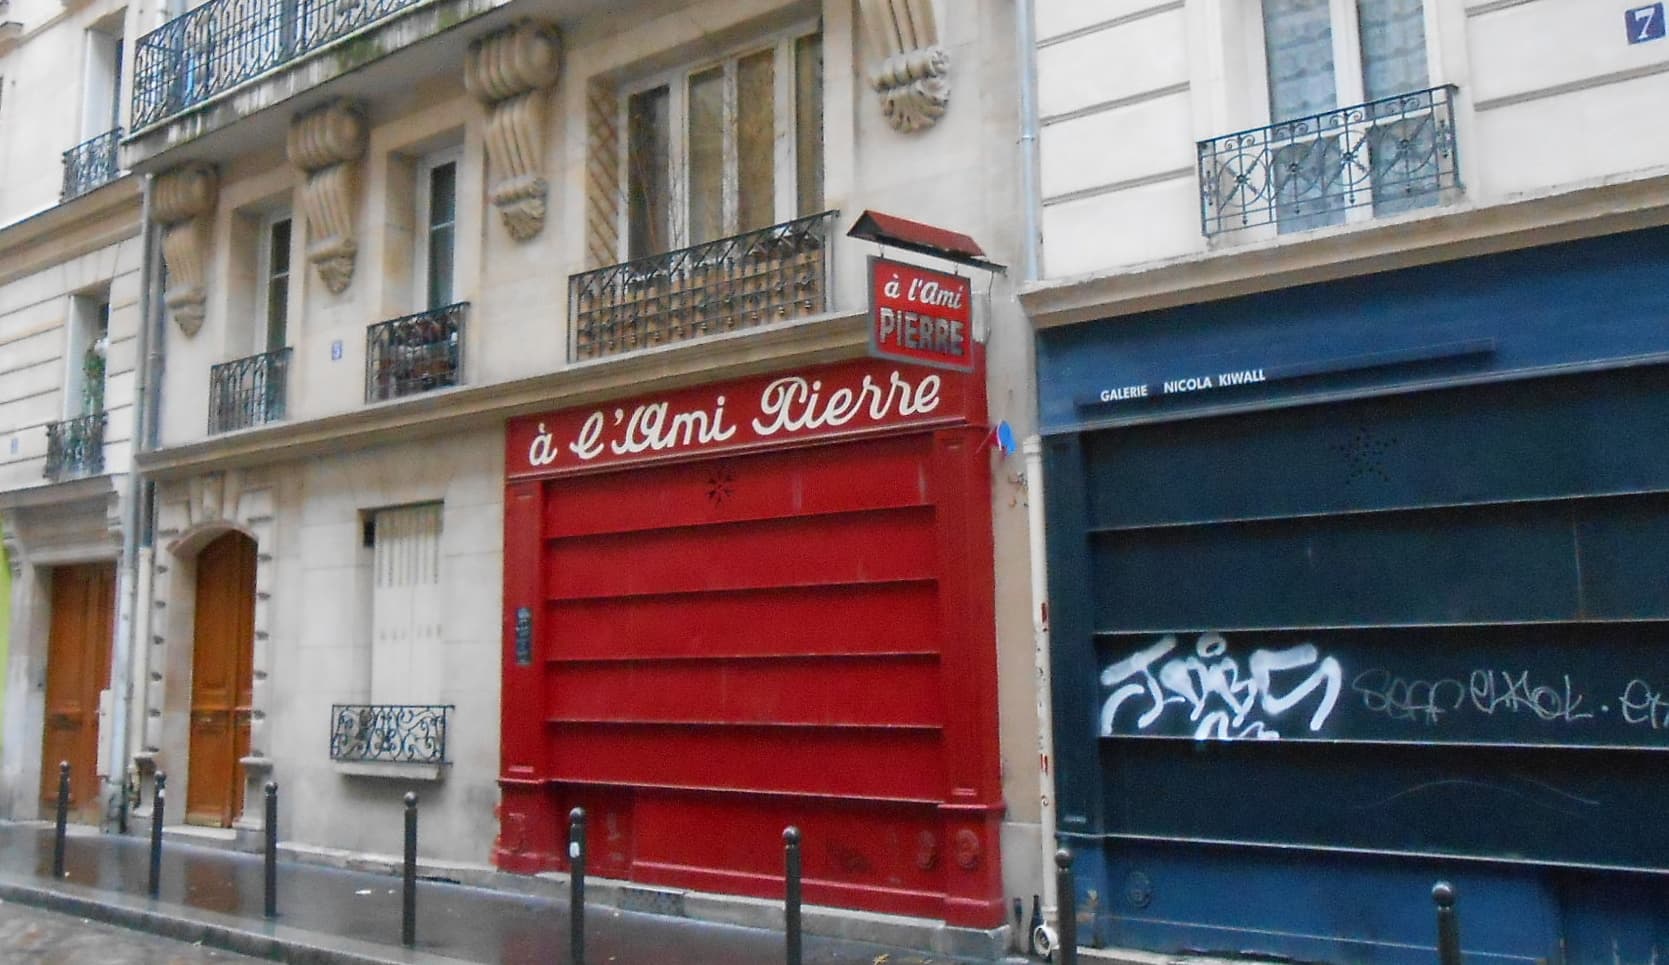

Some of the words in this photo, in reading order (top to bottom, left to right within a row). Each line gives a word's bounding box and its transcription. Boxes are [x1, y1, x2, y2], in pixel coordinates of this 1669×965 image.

[1635, 8, 1655, 39] 7
[884, 273, 900, 298] à
[908, 278, 962, 309] l'Ami
[880, 307, 965, 356] PIERRE
[1100, 384, 1148, 402] GALERIE
[1163, 376, 1213, 394] NICOLA
[1218, 368, 1266, 387] KIWALL
[529, 422, 558, 466] à
[569, 395, 736, 460] l'Ami
[752, 370, 941, 435] Pierre
